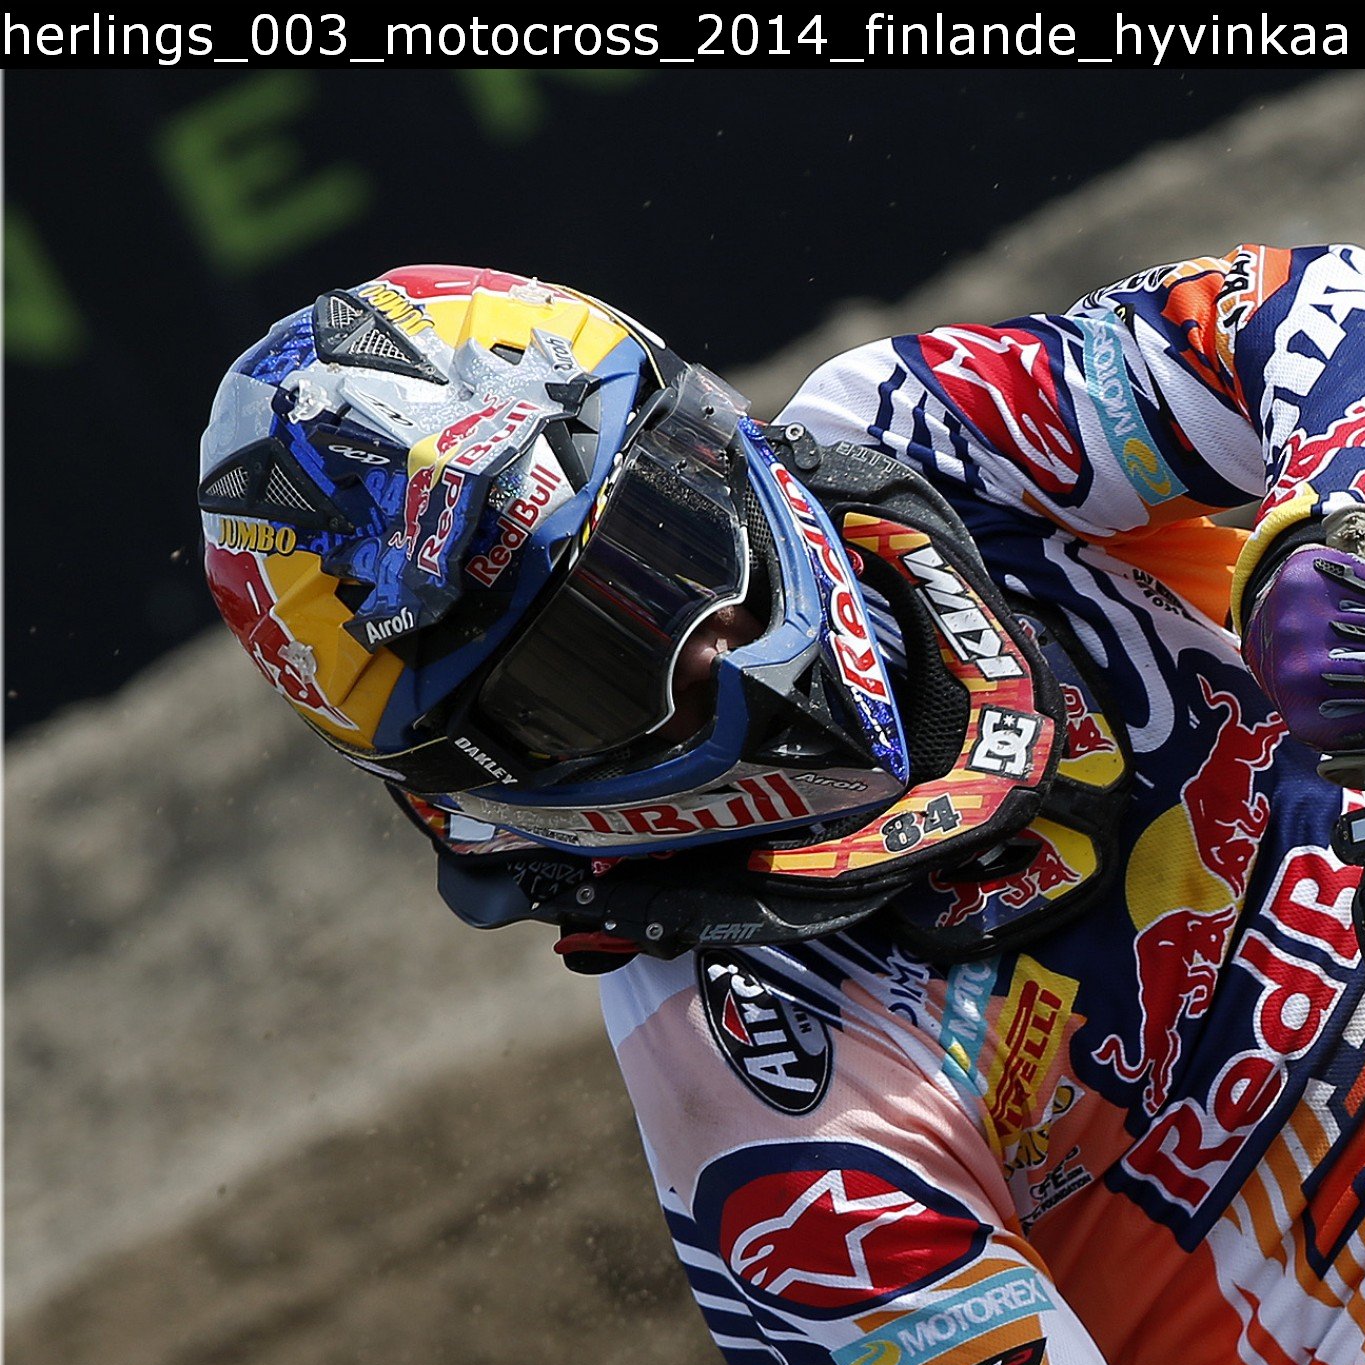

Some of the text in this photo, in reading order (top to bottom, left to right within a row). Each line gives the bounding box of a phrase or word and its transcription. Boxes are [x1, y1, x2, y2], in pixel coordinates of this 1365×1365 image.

[217, 517, 298, 557] JUMBO
[453, 735, 519, 787] OAKLEY
[793, 769, 869, 793] Airoh
[879, 792, 961, 854] 84
[700, 920, 765, 943] LEATT
[896, 1272, 1048, 1357] MOTOREX
